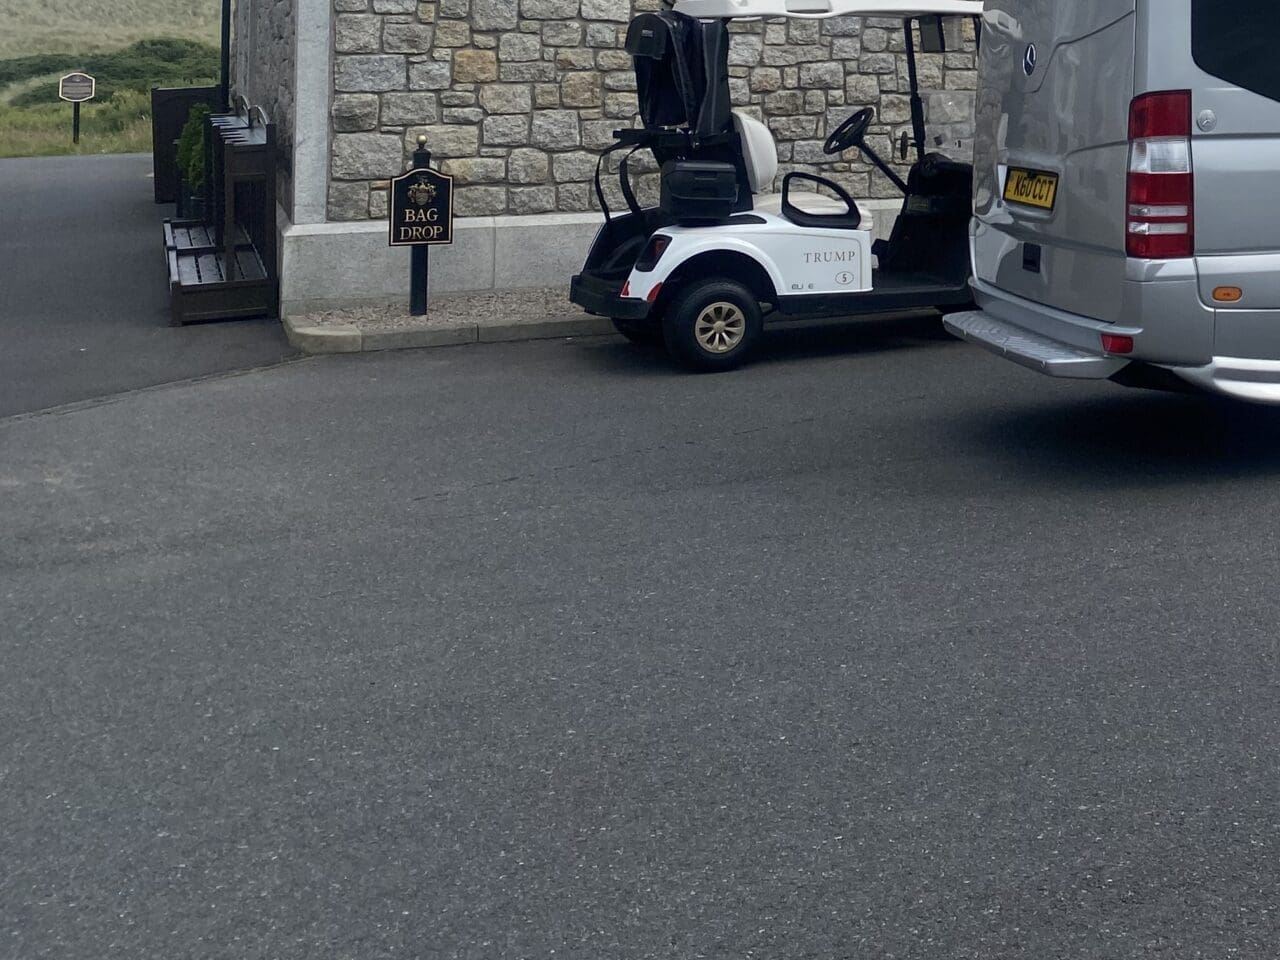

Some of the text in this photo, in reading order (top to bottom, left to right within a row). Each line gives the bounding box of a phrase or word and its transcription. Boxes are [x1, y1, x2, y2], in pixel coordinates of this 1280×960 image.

[404, 208, 439, 222] BAG
[400, 225, 444, 240] DROP
[803, 251, 856, 263] TRUMP
[842, 273, 847, 283] 5
